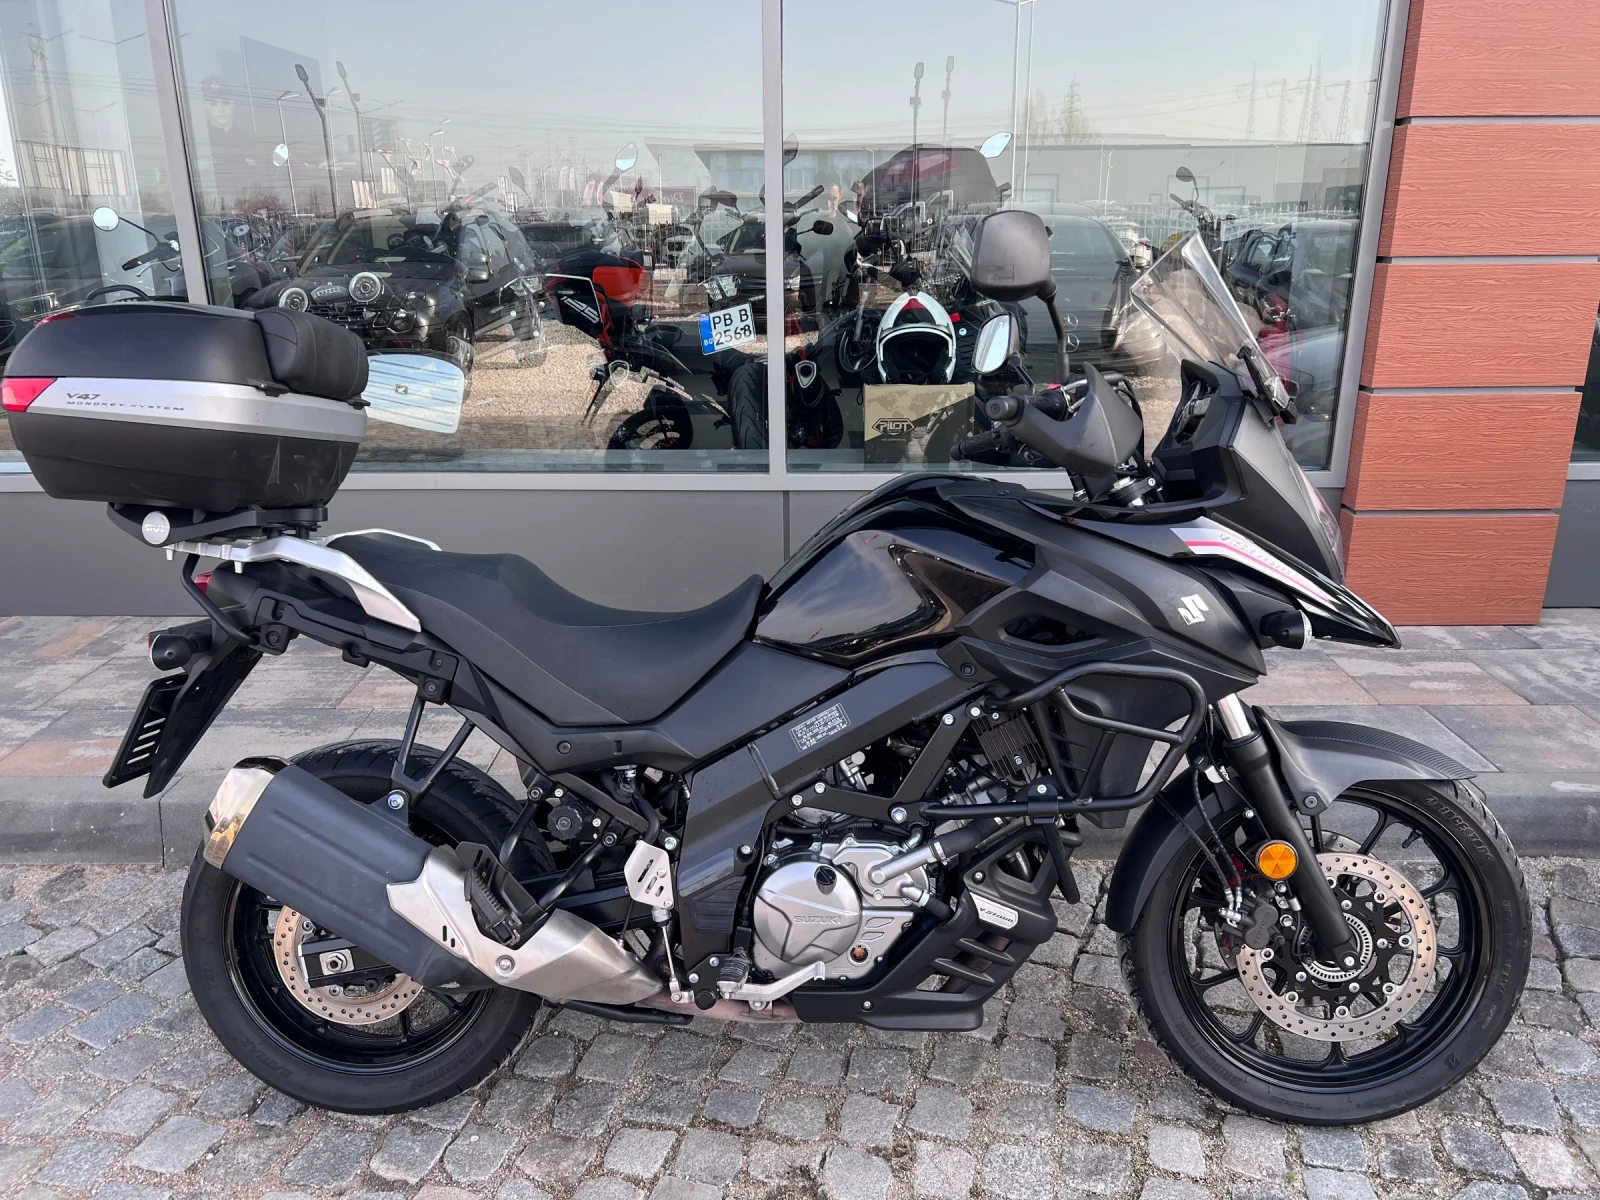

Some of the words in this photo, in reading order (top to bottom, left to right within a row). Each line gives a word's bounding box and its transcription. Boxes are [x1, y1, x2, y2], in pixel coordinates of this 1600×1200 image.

[712, 313, 733, 330] PB
[738, 308, 749, 323] B
[714, 324, 752, 346] 2568
[794, 915, 841, 925] SUZUKI
